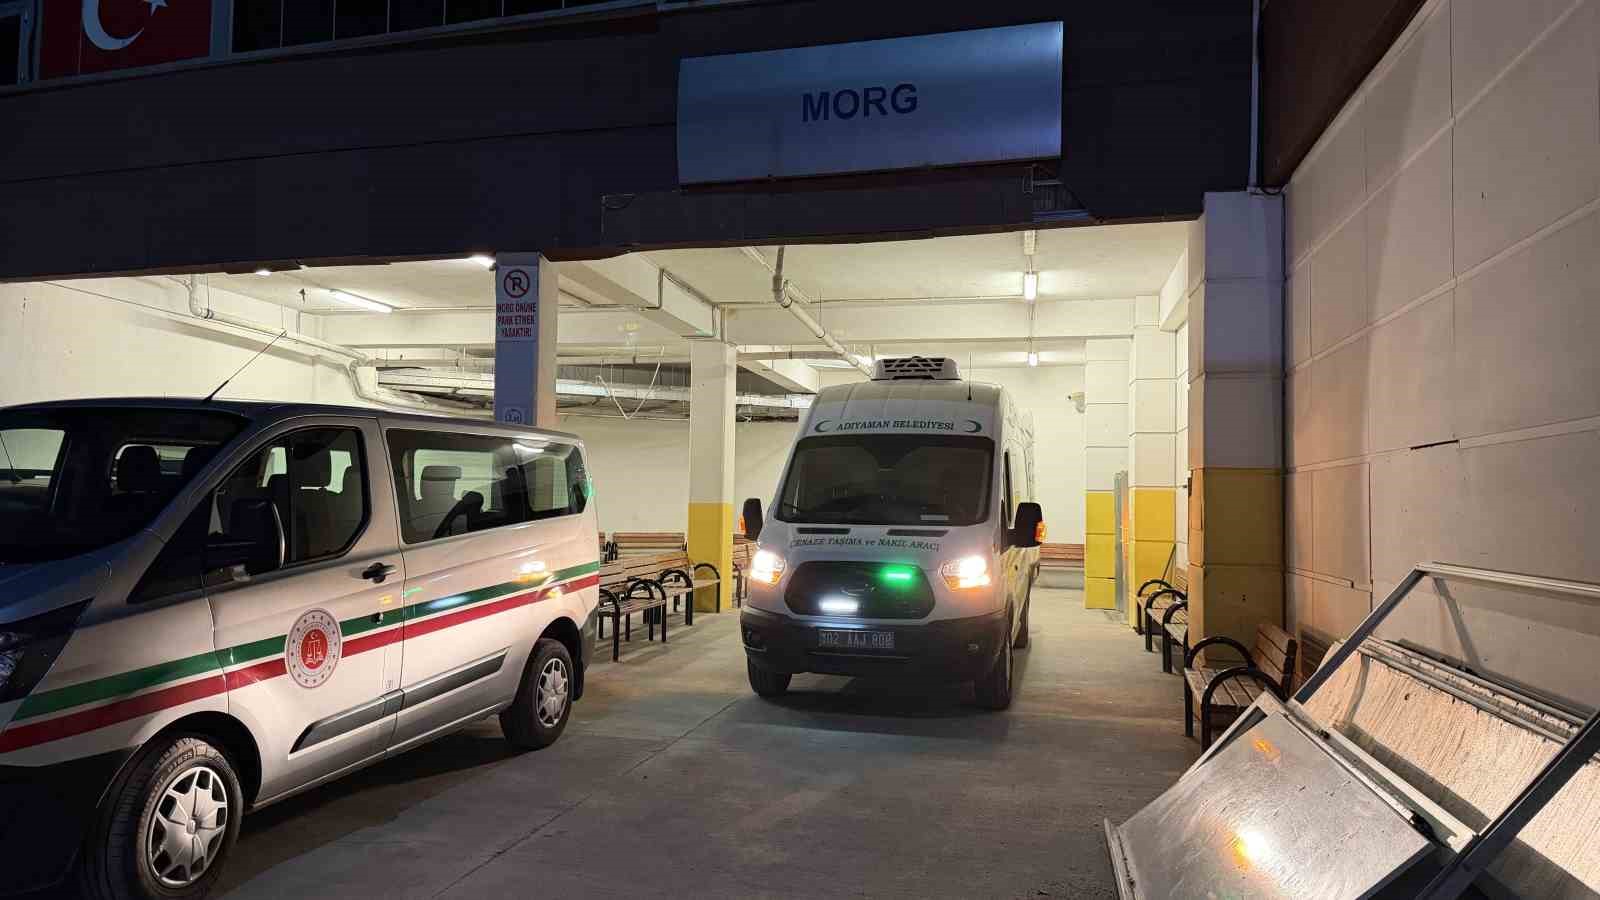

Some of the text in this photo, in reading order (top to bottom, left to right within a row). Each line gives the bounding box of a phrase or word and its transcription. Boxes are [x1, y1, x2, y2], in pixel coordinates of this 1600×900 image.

[801, 83, 918, 122] MORG
[497, 303, 514, 313] MORG
[497, 315, 513, 325] PARK
[836, 420, 890, 431] ADIYAMAN
